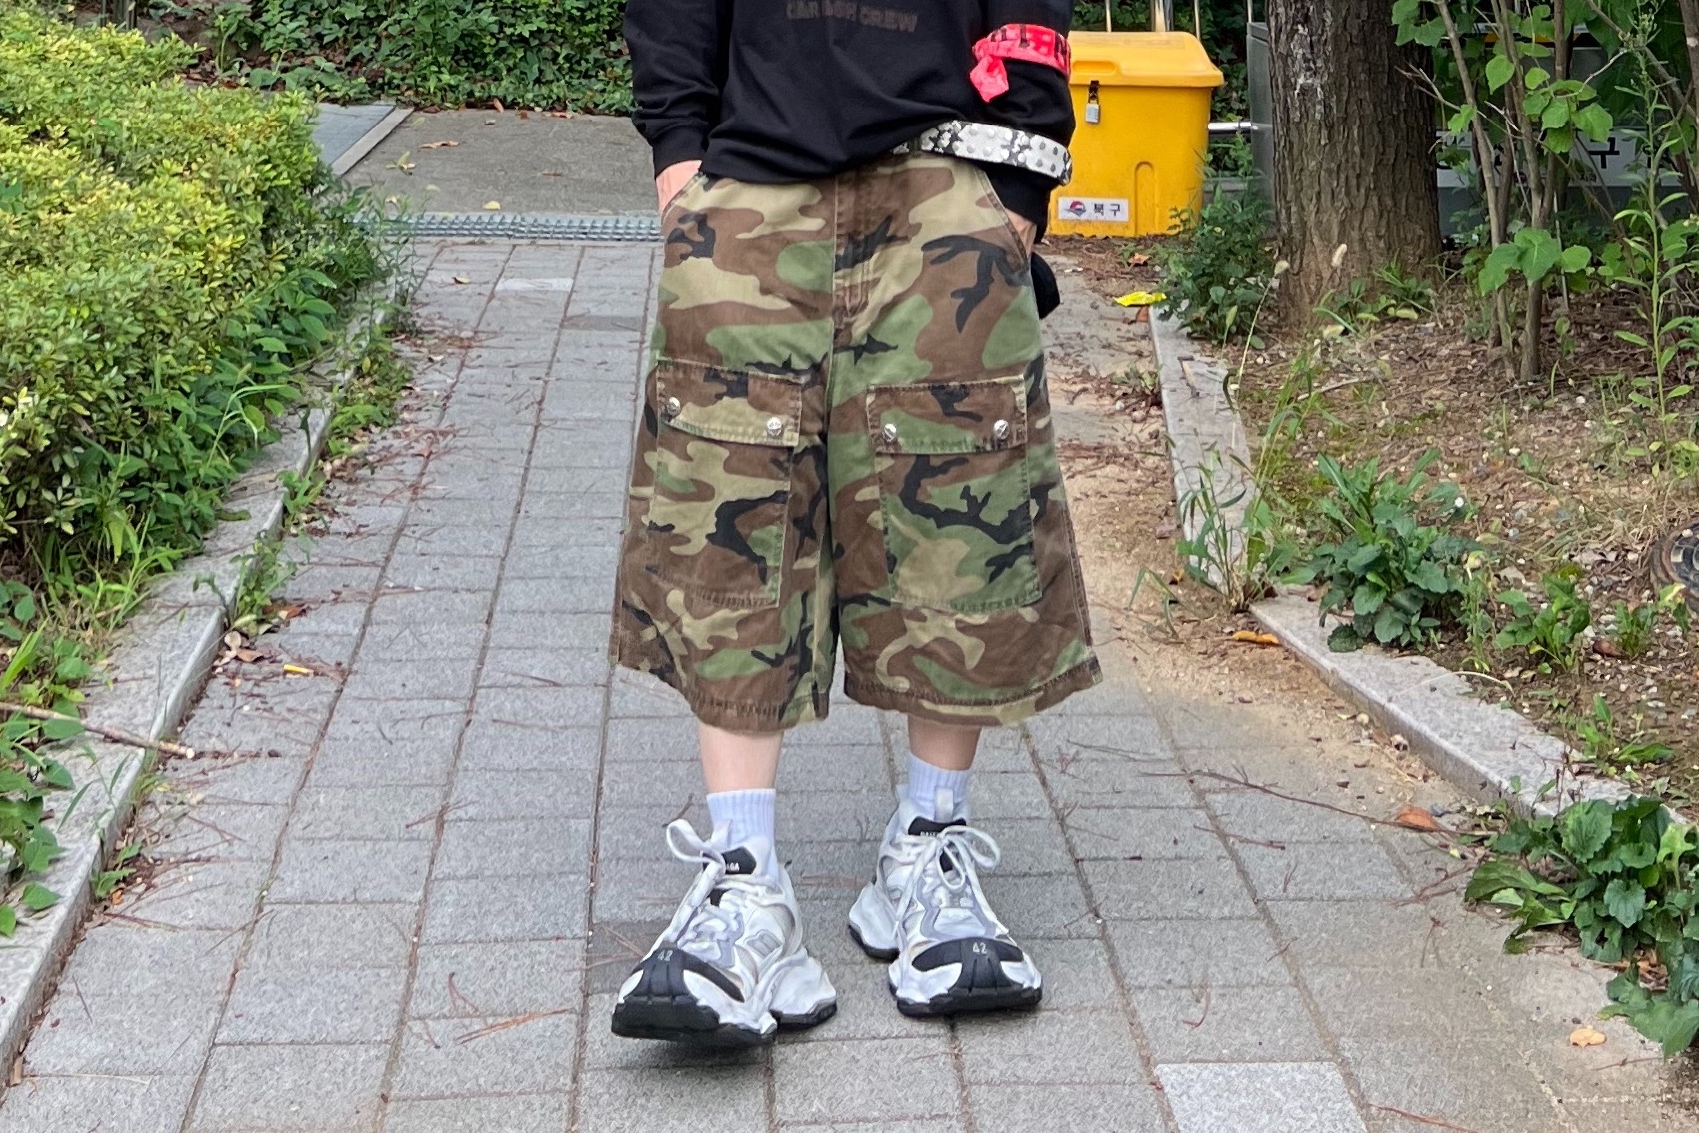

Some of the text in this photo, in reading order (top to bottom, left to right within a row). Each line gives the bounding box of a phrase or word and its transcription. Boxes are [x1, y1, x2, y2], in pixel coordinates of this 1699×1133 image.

[1094, 203, 1121, 216] 북구
[972, 941, 987, 955] 42
[657, 950, 673, 963] 42
